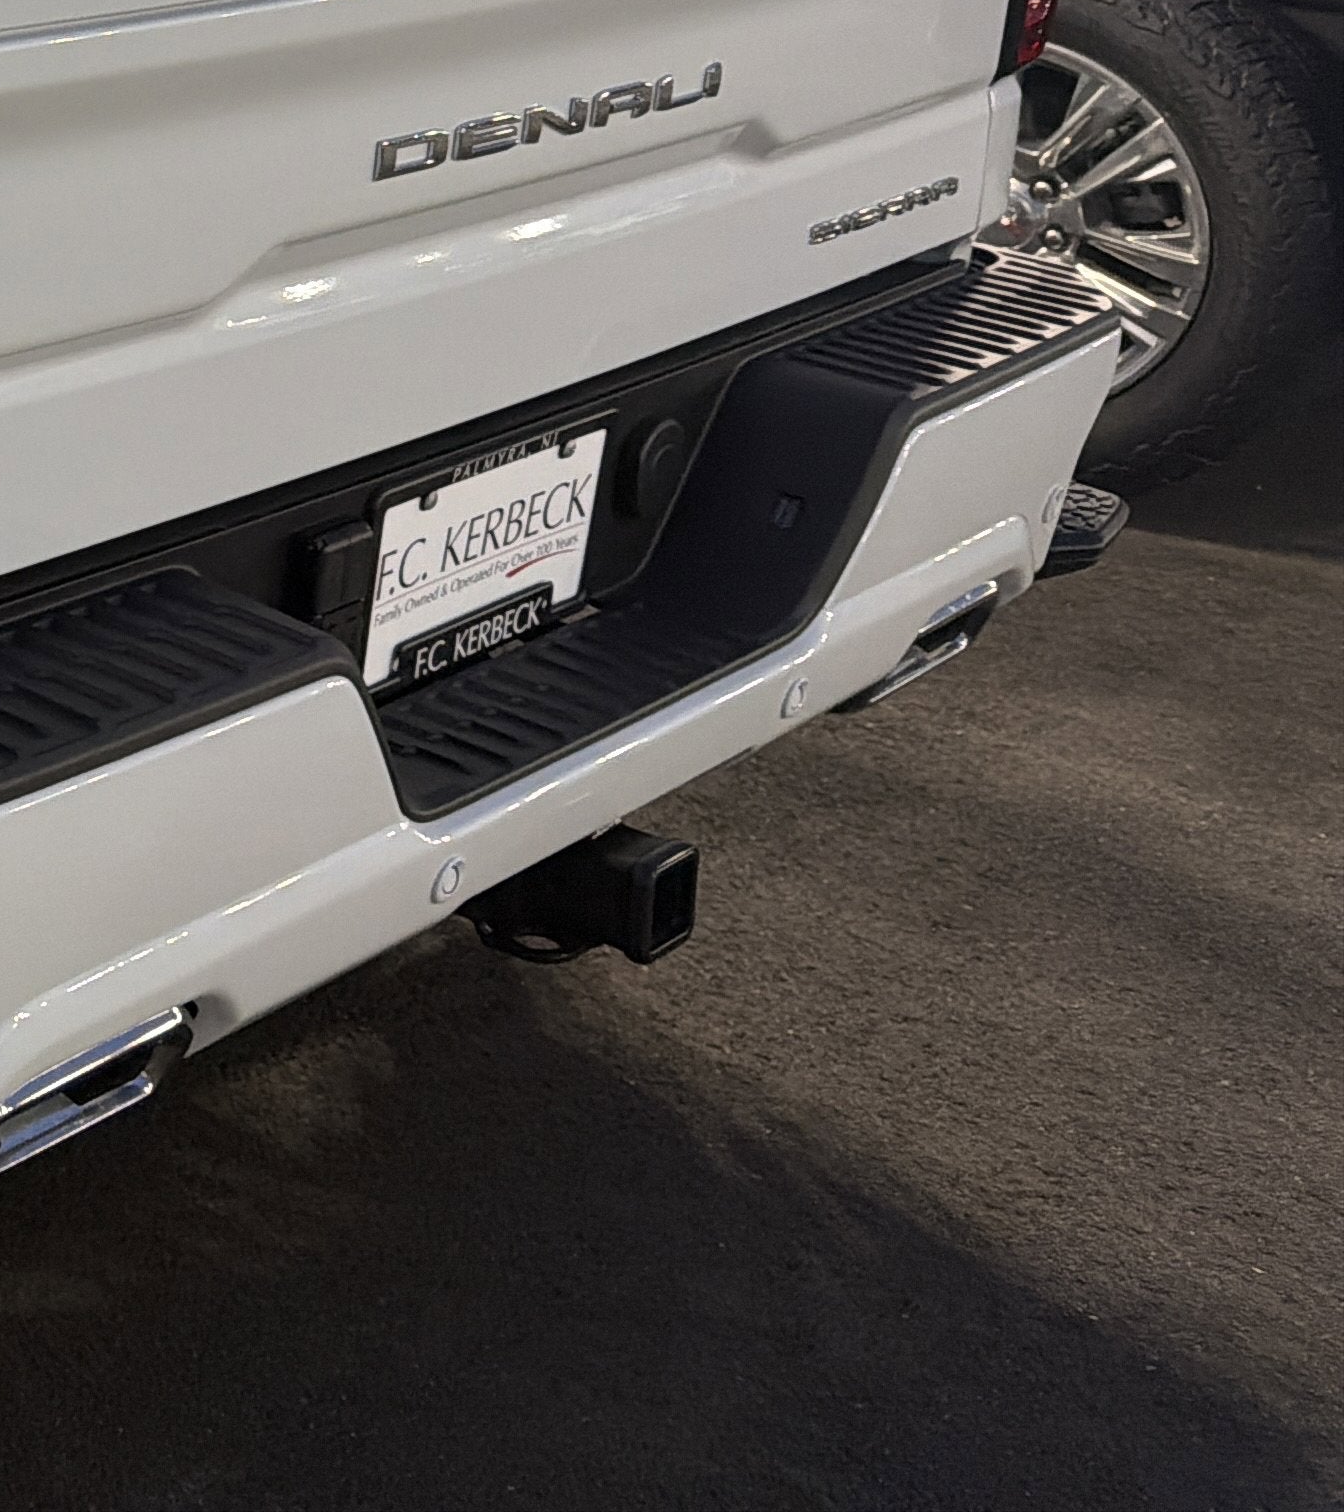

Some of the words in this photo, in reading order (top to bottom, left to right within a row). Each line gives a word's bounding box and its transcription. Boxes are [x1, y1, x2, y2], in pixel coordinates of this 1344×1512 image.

[371, 61, 722, 182] DENALI
[376, 539, 428, 601] F.C.
[440, 473, 593, 572] KERBECK
[405, 585, 439, 613] Owned
[453, 597, 540, 662] KERBECK
